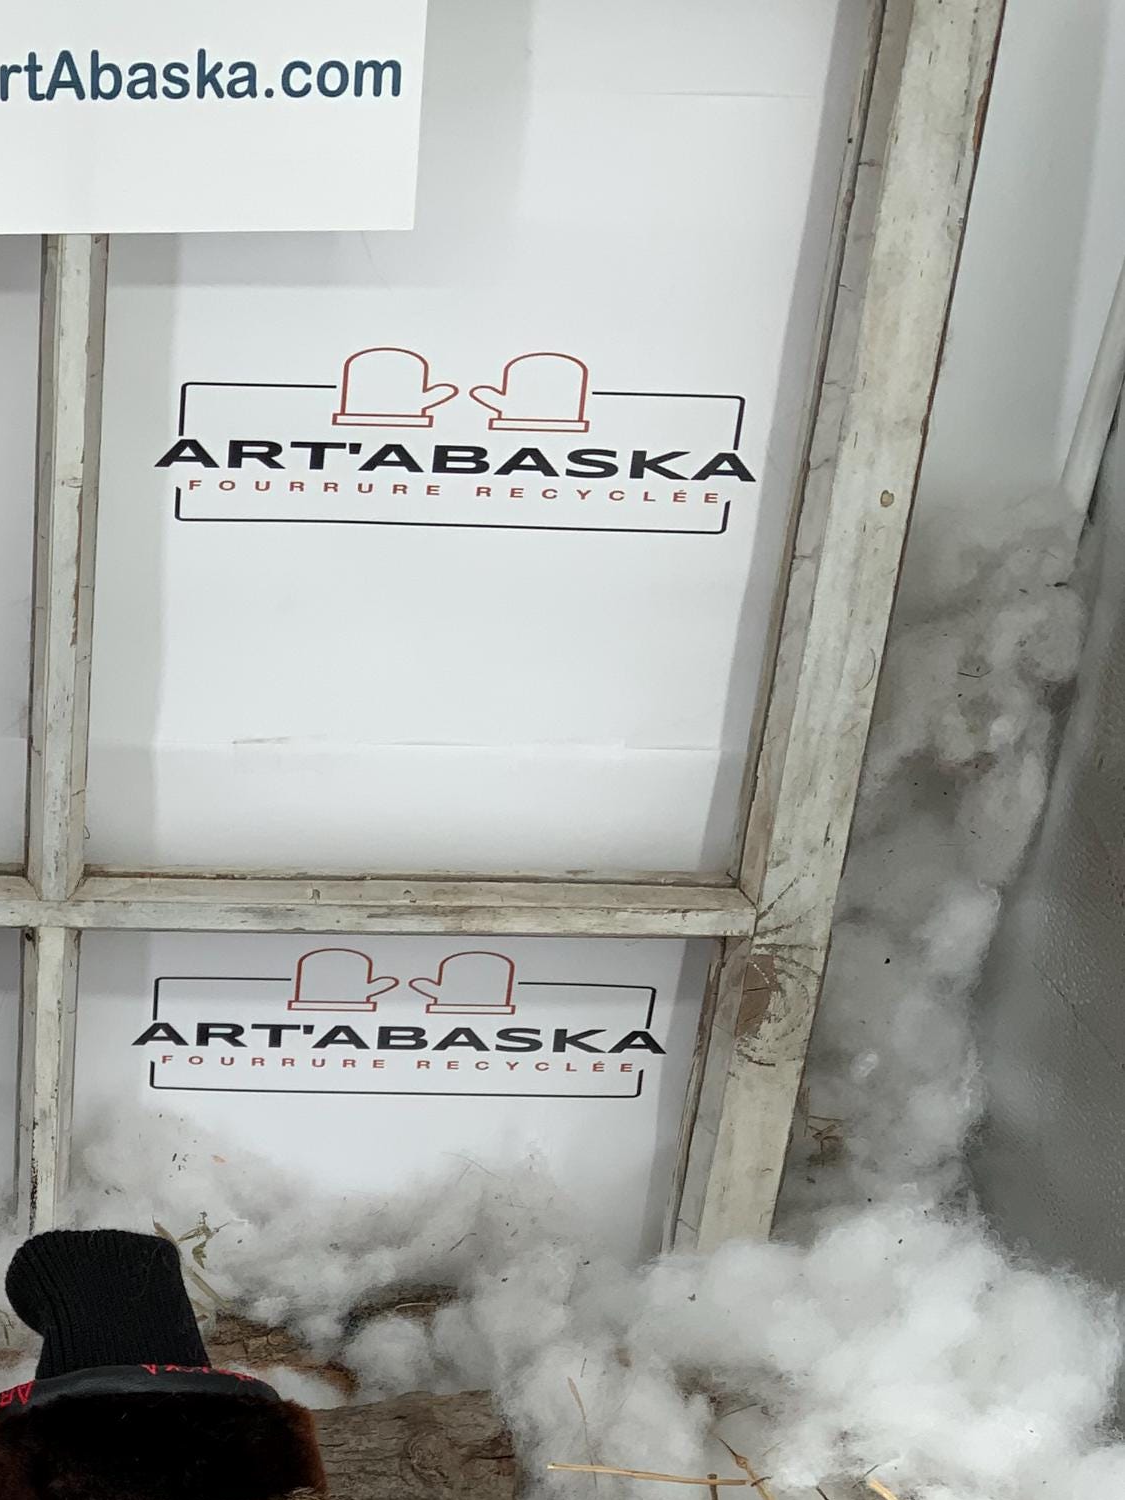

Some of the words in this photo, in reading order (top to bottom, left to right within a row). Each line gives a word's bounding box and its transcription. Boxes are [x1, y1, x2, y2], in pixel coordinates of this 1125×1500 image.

[154, 438, 757, 482] ART'ABASKA
[187, 479, 441, 497] FOURRURE
[476, 486, 719, 504] RECYCLÉE
[131, 1022, 668, 1055] ART'ABASKA
[161, 1055, 387, 1069] FOURRURE
[417, 1060, 635, 1073] RECYCLÉE
